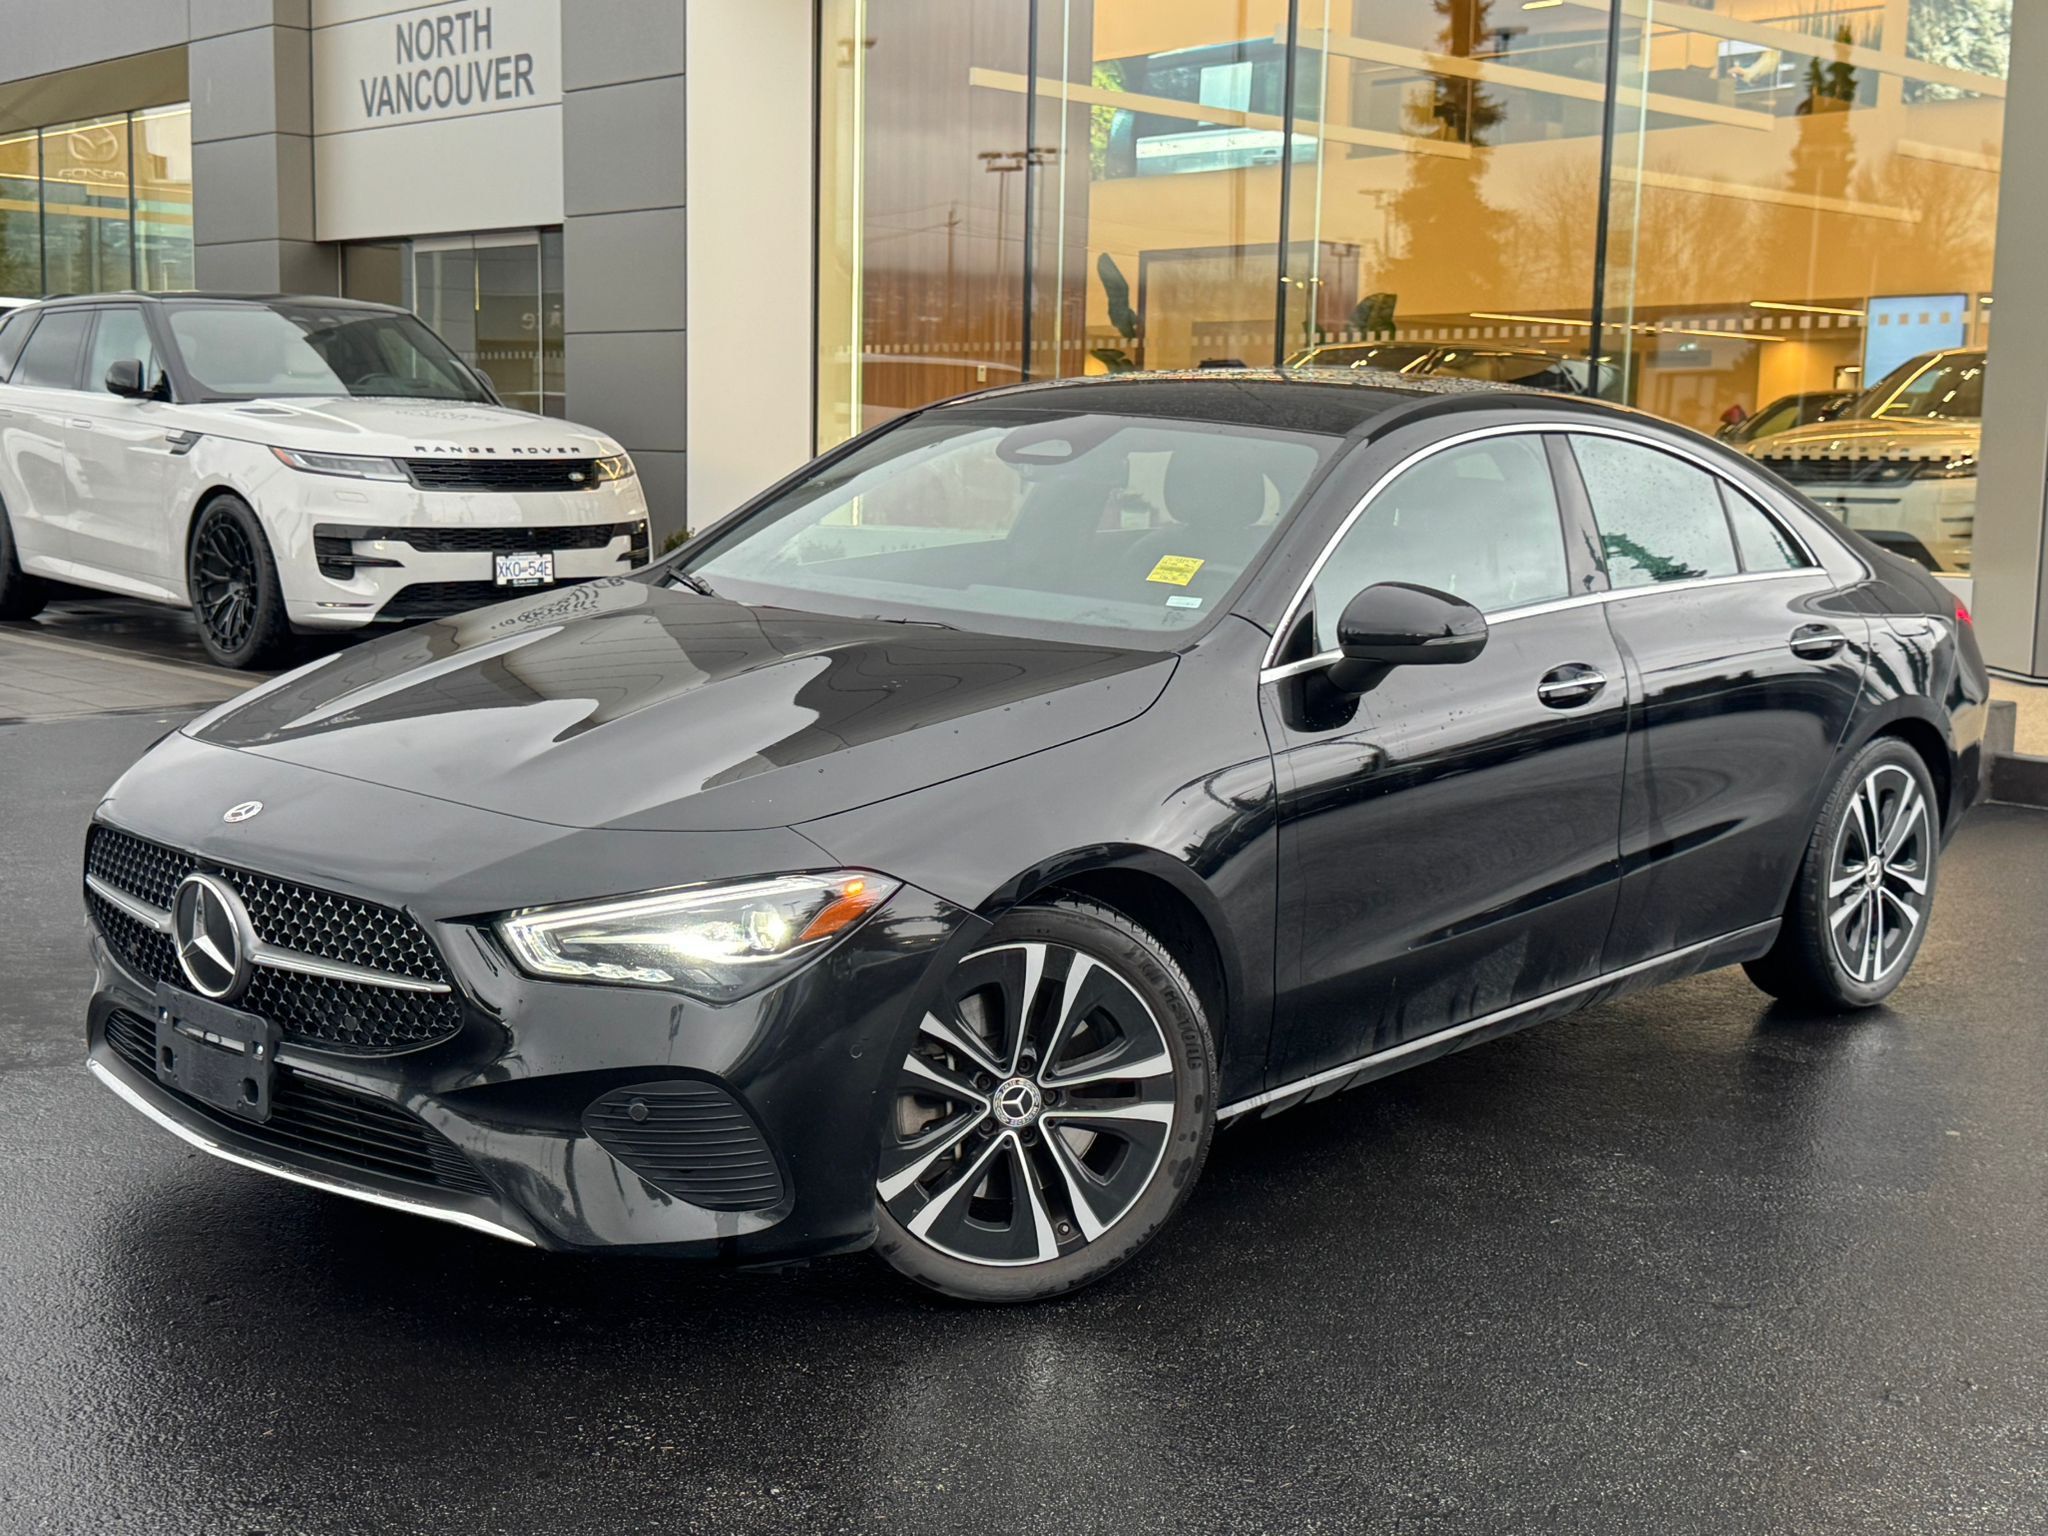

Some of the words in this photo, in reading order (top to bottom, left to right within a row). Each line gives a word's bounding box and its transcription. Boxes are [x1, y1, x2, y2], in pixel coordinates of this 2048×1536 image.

[397, 7, 491, 64] NORTH
[360, 53, 535, 117] VANCOUVER
[414, 446, 496, 454] RANGE
